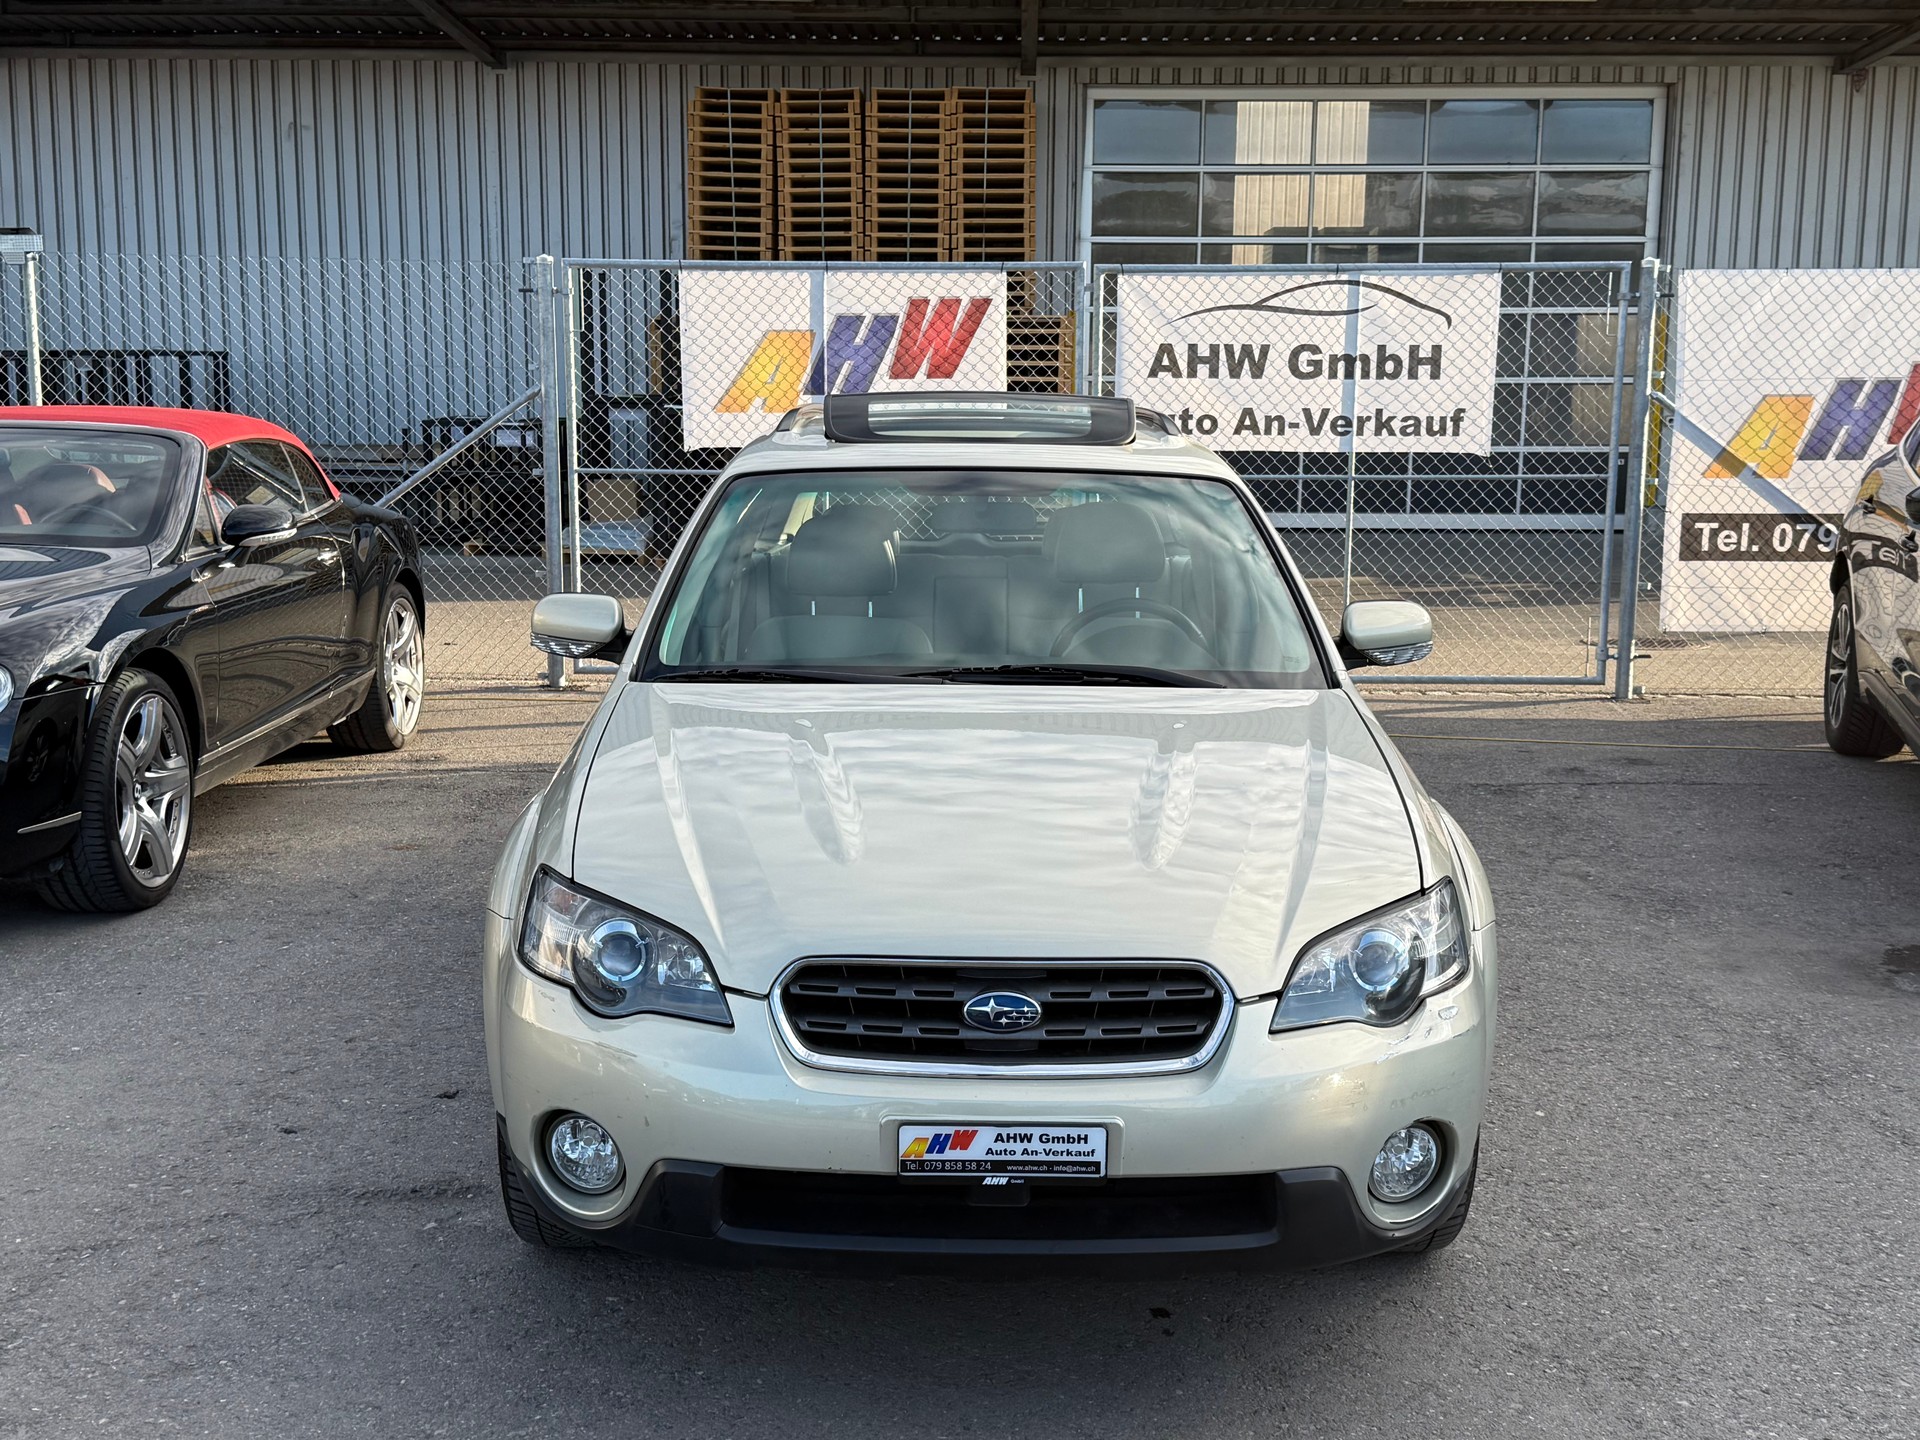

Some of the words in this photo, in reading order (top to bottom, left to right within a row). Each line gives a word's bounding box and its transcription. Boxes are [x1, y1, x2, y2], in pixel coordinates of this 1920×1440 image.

[714, 295, 993, 414] AHW
[1147, 342, 1270, 380] AHW
[1287, 343, 1443, 381] GmbH
[1233, 407, 1466, 438] An-Verkauf
[1694, 522, 1760, 553] Tel.
[1772, 523, 1838, 553] 079
[900, 1129, 979, 1159] AHW
[993, 1132, 1034, 1144] AHW
[1038, 1133, 1089, 1145] GmbH
[985, 1147, 1017, 1157] Auto
[1020, 1147, 1096, 1158] An-Verkauf
[905, 1161, 922, 1171] Tel.
[924, 1161, 942, 1171] 079
[944, 1161, 963, 1171] 858
[965, 1161, 977, 1171] 58
[979, 1161, 992, 1171] 24
[1006, 1164, 1048, 1172] www.ahw.ch
[1053, 1164, 1096, 1173] info@ahw.ch
[982, 1177, 1009, 1186] AHW
